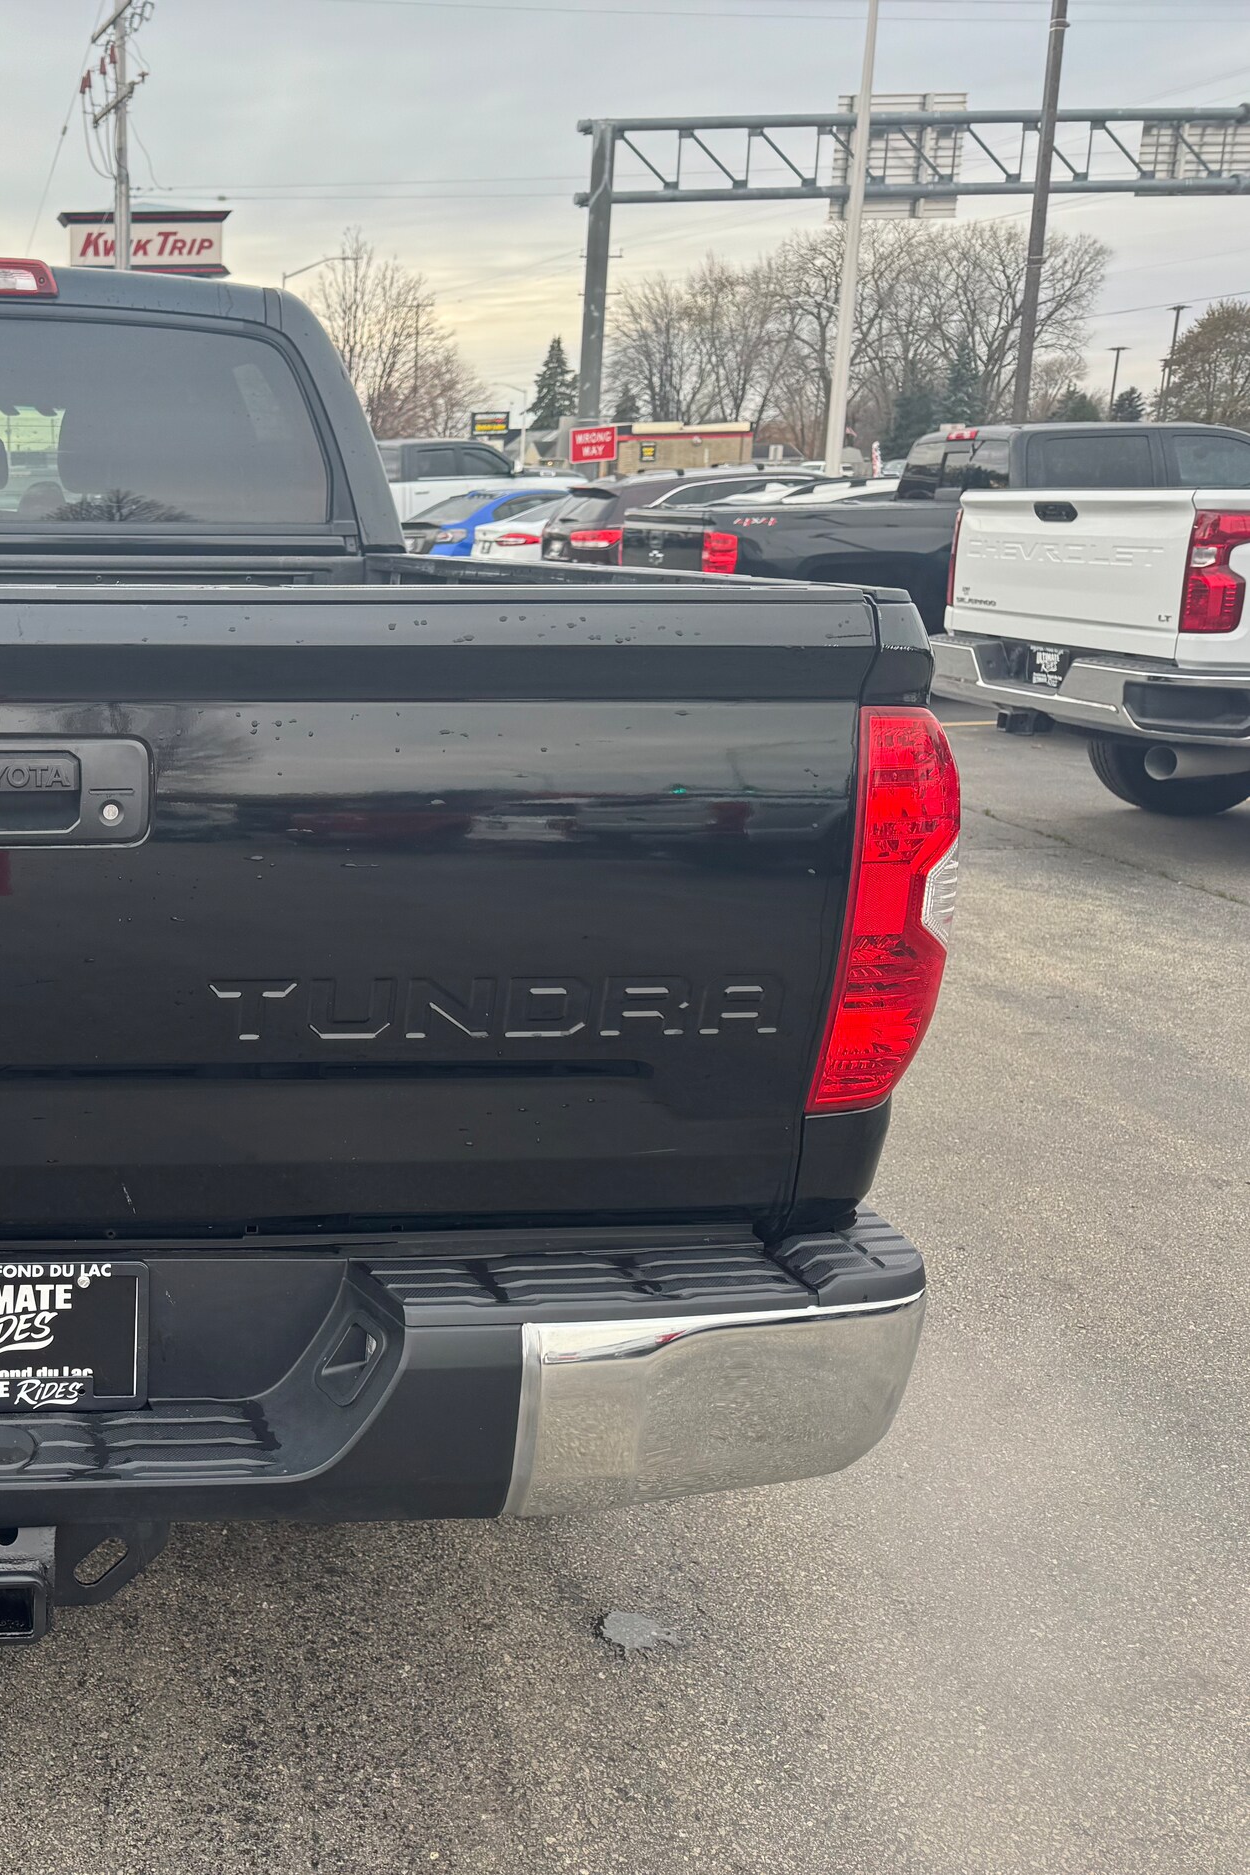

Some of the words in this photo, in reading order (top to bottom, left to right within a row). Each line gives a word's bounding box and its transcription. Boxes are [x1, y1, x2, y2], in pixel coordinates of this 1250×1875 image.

[80, 232, 152, 257] KWK
[156, 231, 215, 257] TRIP
[576, 432, 612, 444] WRONG
[582, 446, 605, 457] WAY
[966, 539, 1164, 567] CHEVROLET
[1157, 613, 1173, 623] LT
[207, 977, 780, 1041] TUNDRA
[50, 1264, 74, 1278] DU
[81, 1263, 112, 1278] LAC
